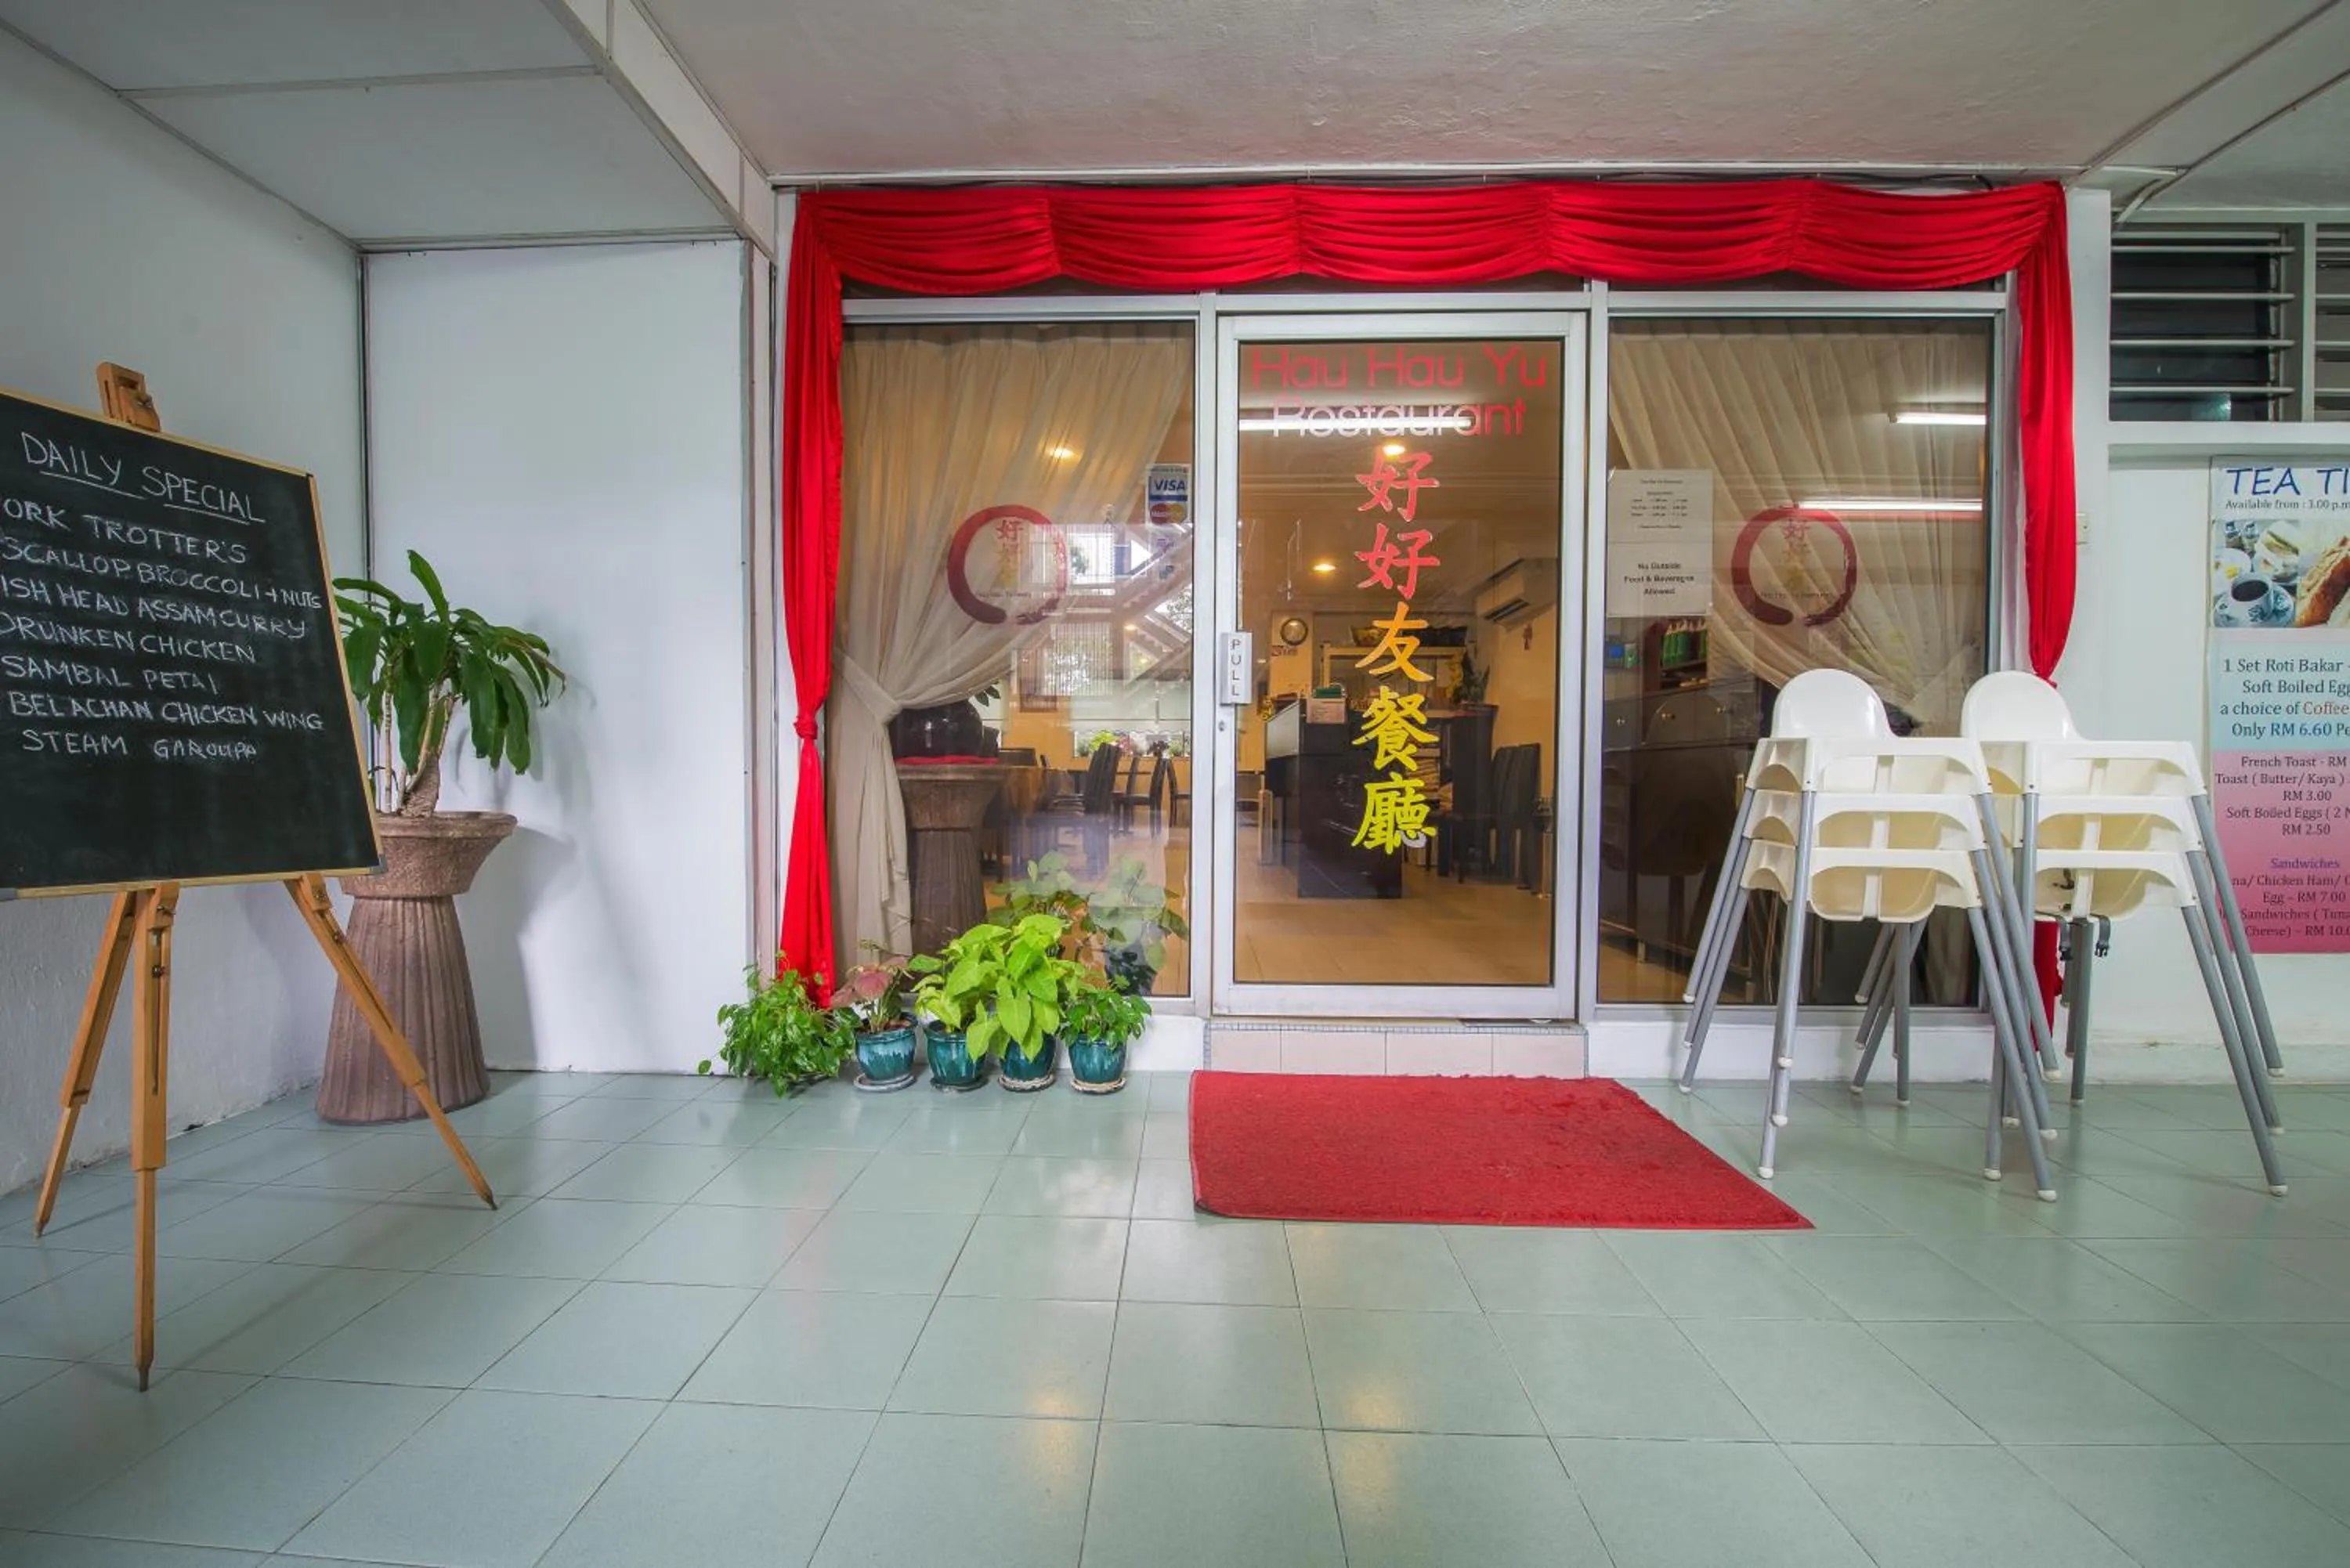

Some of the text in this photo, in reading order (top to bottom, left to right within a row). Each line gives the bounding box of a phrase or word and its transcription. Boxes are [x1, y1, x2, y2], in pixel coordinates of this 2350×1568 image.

[1253, 344, 1546, 389] Hau Hau Yu
[1273, 396, 1526, 438] Restaurant
[21, 432, 266, 523] DAILY SPECIAL
[2226, 467, 2301, 496] TEA
[1154, 479, 1187, 492] VISA
[2225, 498, 2272, 510] Available
[2275, 499, 2299, 510] from
[2, 536, 131, 578] SCALLOP
[137, 562, 260, 600] BROCCOLI
[56, 583, 129, 616] HEAD
[138, 597, 217, 627] ASSAM
[219, 609, 306, 639] CURRY
[0, 612, 256, 664] DRUNKEN CHICKEN
[1231, 638, 1242, 696] PULL
[2224, 658, 2344, 673] 1 Set Roti Bakar
[2, 655, 218, 695] SAMBAL PETAI
[2243, 679, 2272, 694] Soft
[2277, 679, 2324, 694] Boiled
[2220, 702, 2349, 715] a choice of Coffee
[161, 702, 258, 726] CHICKEN
[262, 710, 324, 731] WING
[2232, 722, 2266, 740] Only
[2271, 723, 2295, 736] RM
[2299, 723, 2332, 736] 6.60
[21, 728, 128, 756] STEAM
[2241, 756, 2282, 768] French
[2284, 756, 2316, 768] Toast
[2328, 756, 2347, 768] RM
[2215, 773, 2248, 784] Toast
[2283, 789, 2332, 801] RM 3.00
[2226, 807, 2251, 818] Soft
[2254, 807, 2291, 818] Boiled
[2294, 807, 2323, 821] Eggs
[2334, 807, 2341, 818] 2
[2282, 824, 2331, 835] RM 2.50
[2271, 858, 2341, 869] Sandwiches
[2257, 875, 2304, 886] Chicken
[2263, 891, 2285, 905] Egg
[2298, 891, 2316, 903] RM
[2241, 908, 2310, 920] Sandwiches
[2305, 925, 2324, 937] RM
